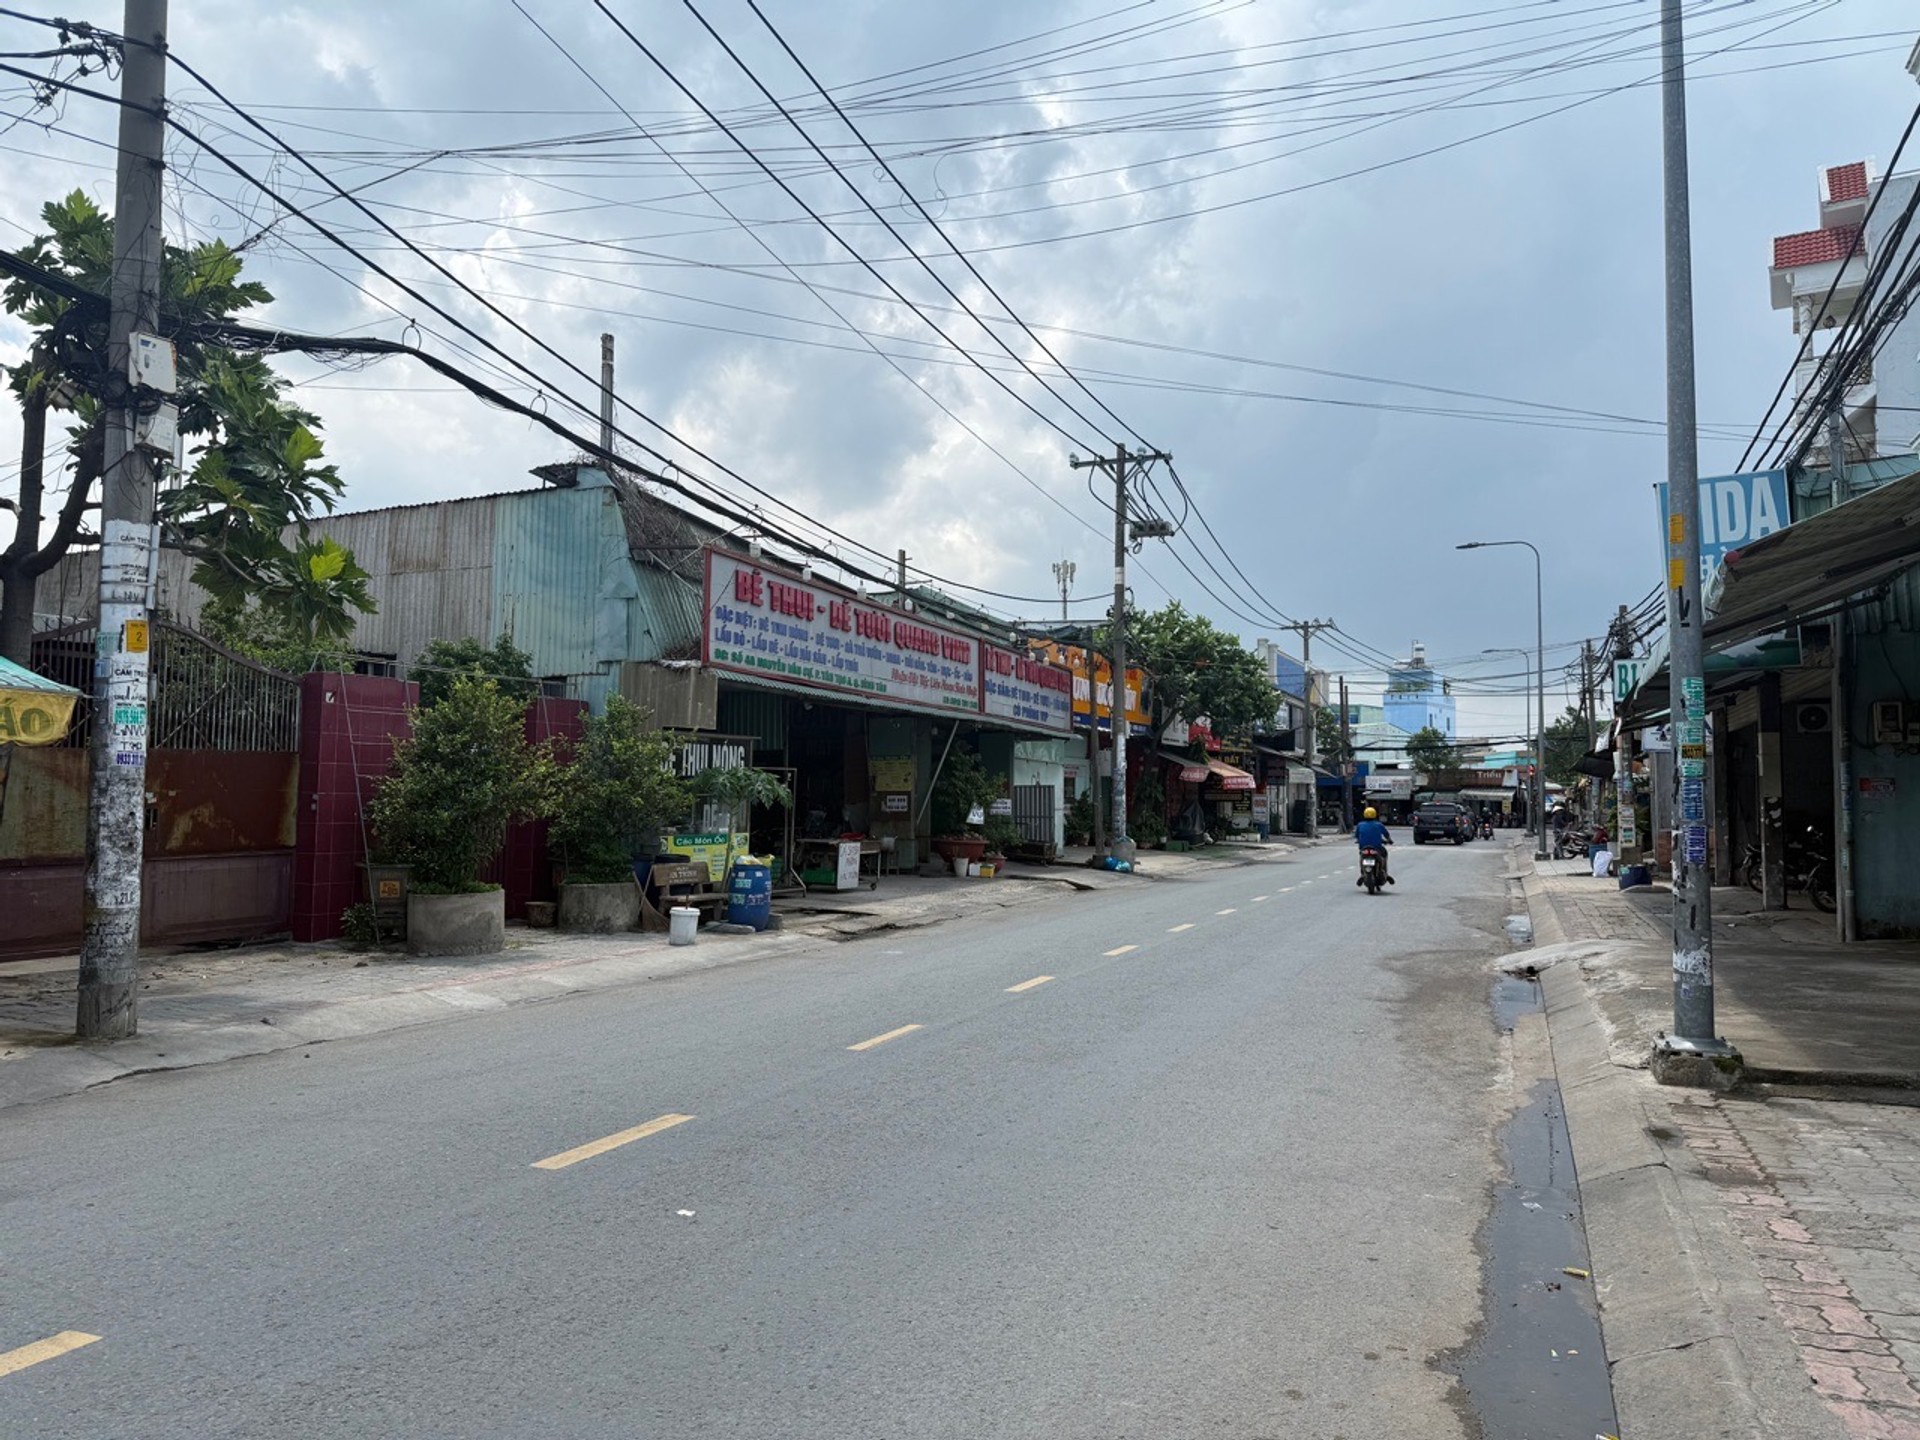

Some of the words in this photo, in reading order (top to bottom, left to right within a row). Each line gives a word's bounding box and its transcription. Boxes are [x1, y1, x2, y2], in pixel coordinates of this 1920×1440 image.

[768, 581, 814, 621] THUI
[894, 622, 939, 656] QUANG
[941, 635, 970, 665] VINH
